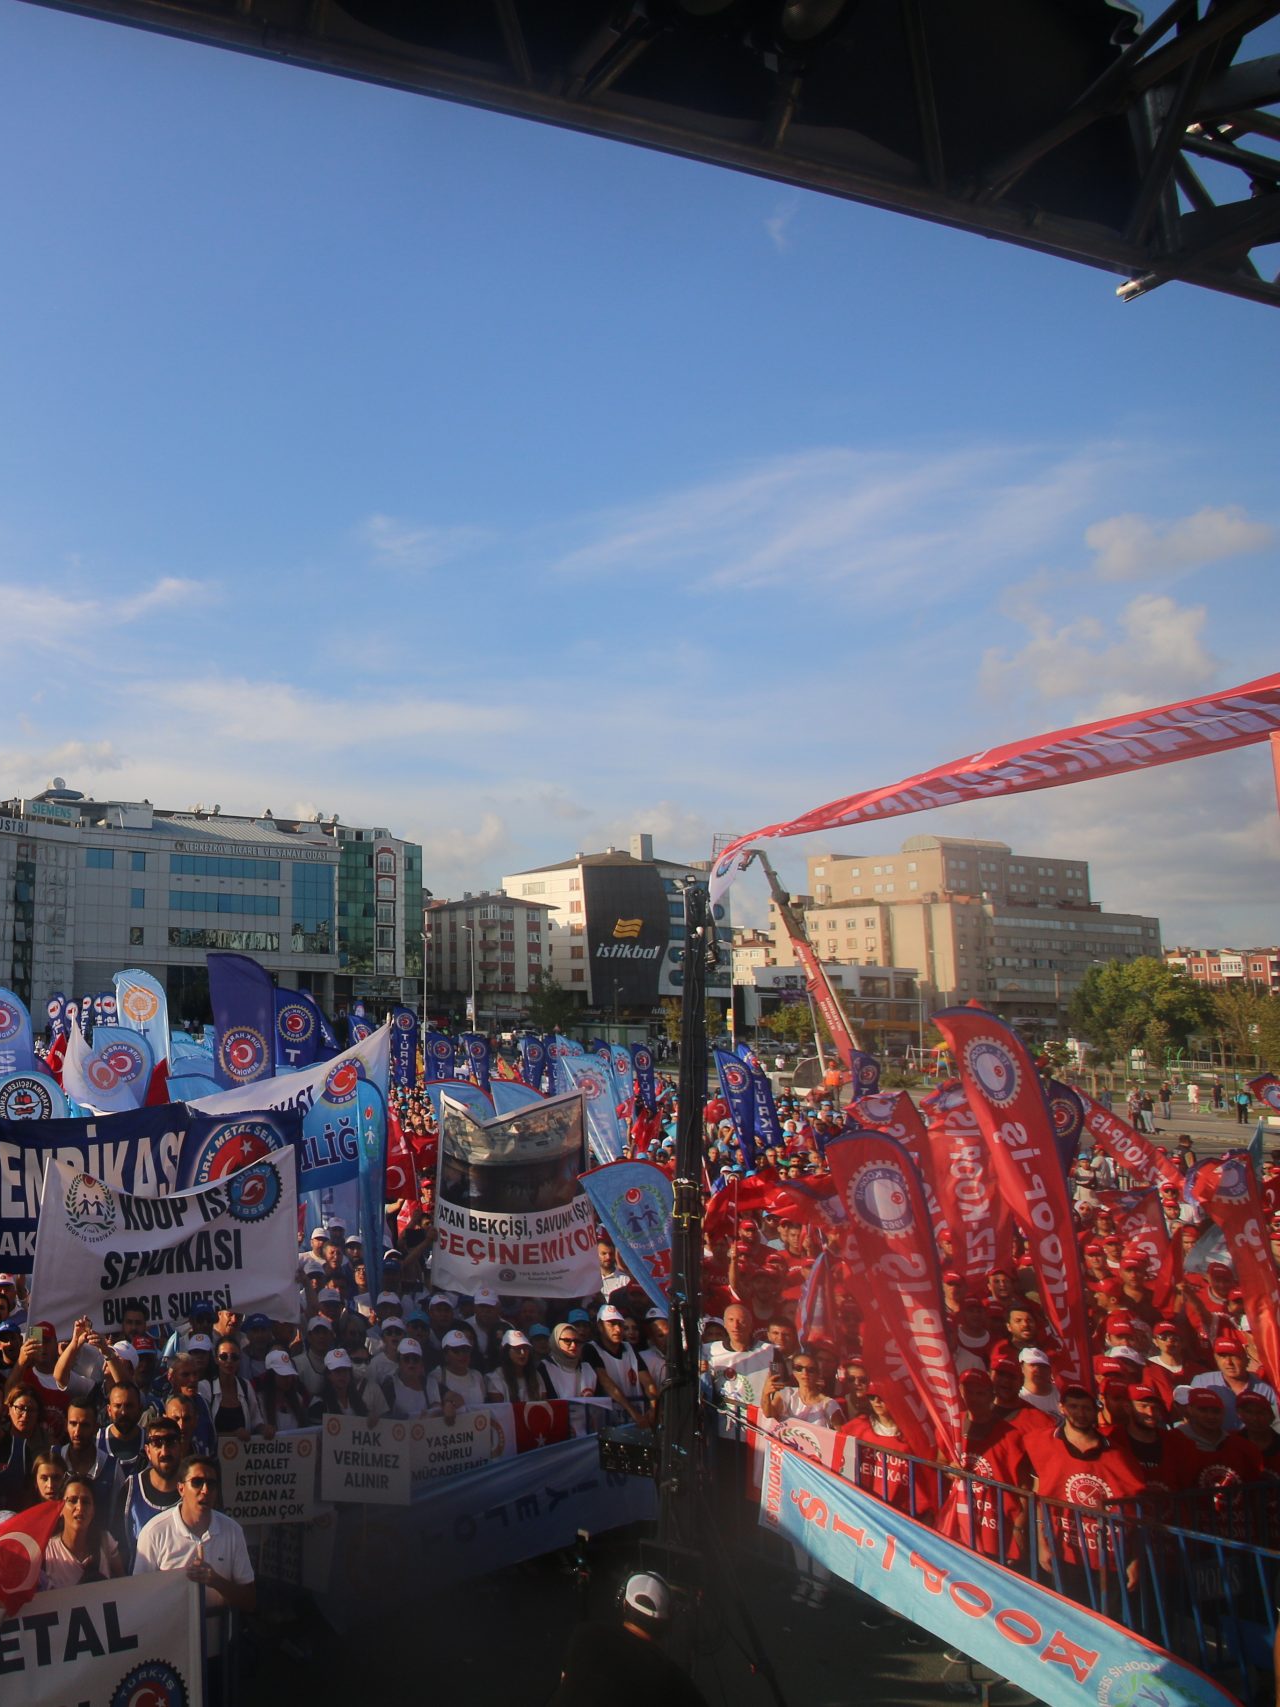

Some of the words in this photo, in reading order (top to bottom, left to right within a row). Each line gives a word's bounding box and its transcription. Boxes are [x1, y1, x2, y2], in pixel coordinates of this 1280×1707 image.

[32, 802, 71, 818] SIEMENS
[263, 848, 275, 856] VE
[305, 850, 329, 861] ODASI
[596, 943, 660, 959] istikbal
[214, 1123, 251, 1149] METAL
[118, 1192, 189, 1231] KOOP
[438, 1223, 596, 1265] GEÇİNEMİYOR
[243, 1439, 293, 1454] VERGİDE
[352, 1430, 381, 1447] HAK
[426, 1431, 475, 1450] YAŞASIN
[334, 1450, 400, 1469] VERİLMEZ
[428, 1446, 473, 1464] ONURLU
[245, 1457, 290, 1471] ADALET
[235, 1471, 297, 1487] İSTİYORUZ
[344, 1472, 389, 1490] ALINIR
[766, 1441, 784, 1527] SENDİKASI
[235, 1490, 278, 1502] AZDAN
[280, 1489, 295, 1501] AZ
[279, 1503, 304, 1519] ÇOK
